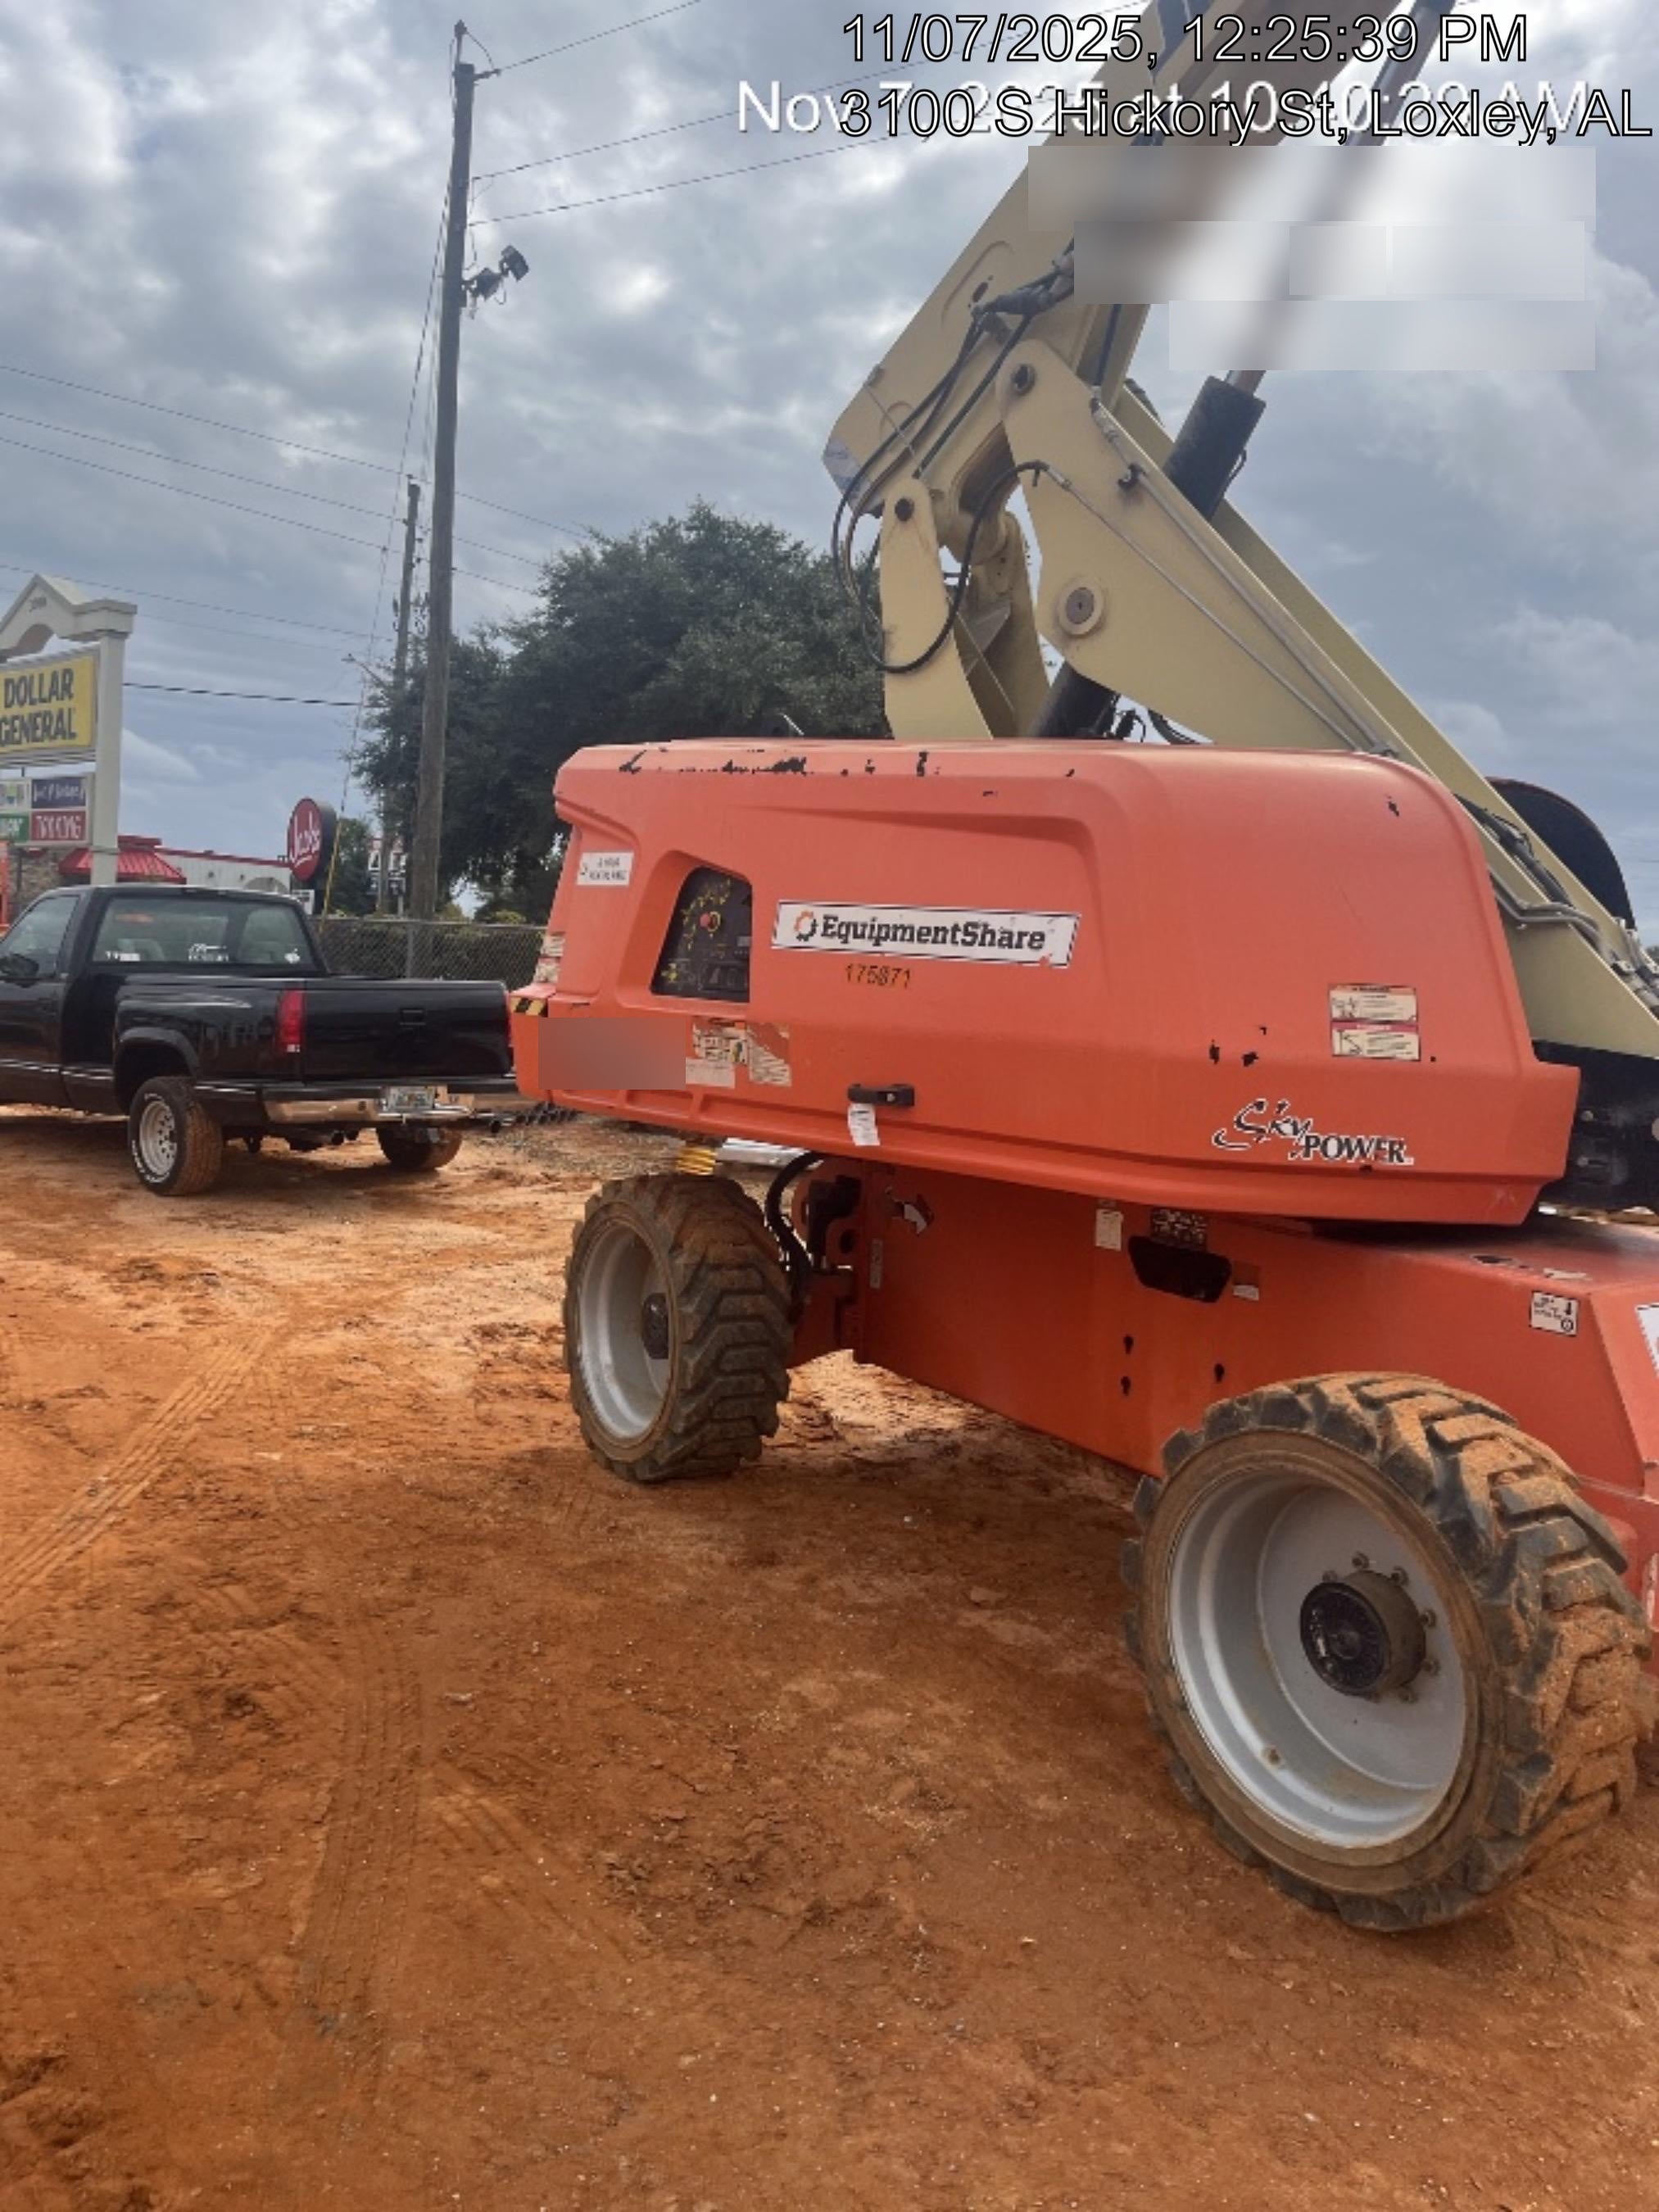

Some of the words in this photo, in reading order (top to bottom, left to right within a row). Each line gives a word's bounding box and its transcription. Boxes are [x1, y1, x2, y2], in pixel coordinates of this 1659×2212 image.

[4, 668, 75, 709] DOLLAR
[0, 707, 78, 746] GENERAL
[820, 913, 1046, 950] EquipmentShare
